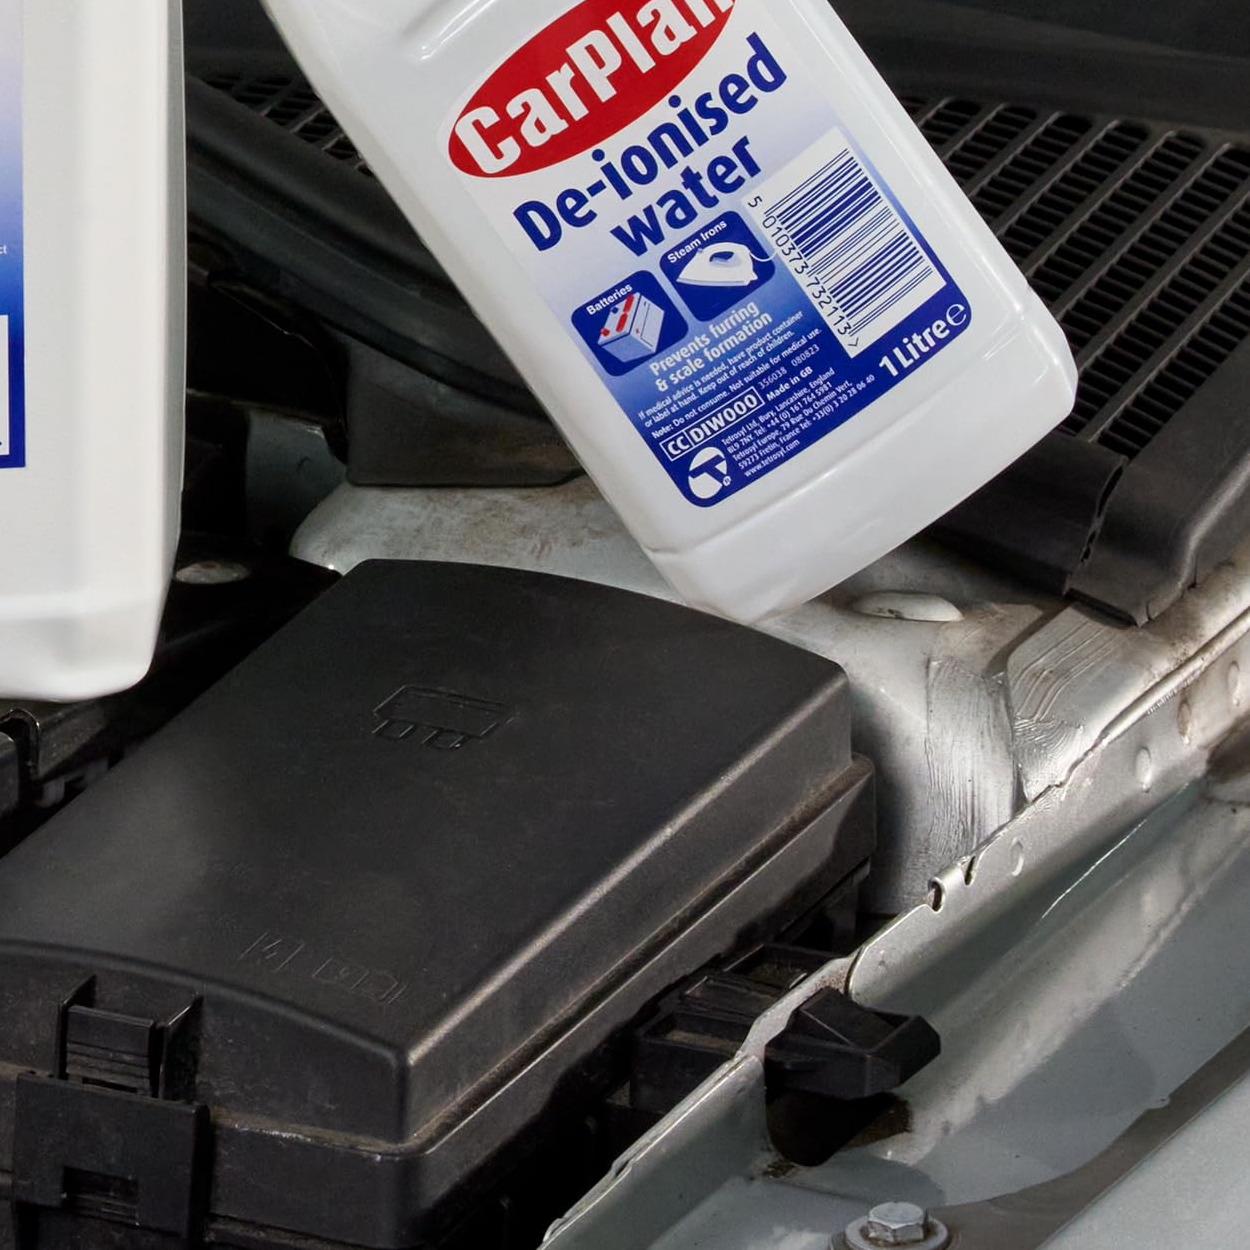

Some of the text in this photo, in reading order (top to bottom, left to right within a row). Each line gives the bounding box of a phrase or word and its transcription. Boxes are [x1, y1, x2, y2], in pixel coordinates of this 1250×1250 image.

[513, 31, 787, 252] De-ionised
[610, 135, 762, 257] water
[667, 220, 727, 263] Steam Irons
[747, 194, 852, 336] 5 010373 732113
[586, 284, 632, 315] Batteries
[637, 411, 645, 420] If
[645, 395, 672, 416] medical
[672, 384, 694, 401] advice
[700, 361, 729, 383] needed,
[726, 350, 746, 365] have
[745, 332, 773, 356] product
[771, 310, 803, 335] container
[648, 301, 760, 376] Prevents furring
[655, 312, 772, 392] & scale formation
[757, 343, 820, 389] 356038 080823
[878, 355, 898, 377] 1
[892, 319, 950, 368] Litre
[644, 419, 653, 427] or
[651, 407, 670, 423] label
[670, 403, 679, 412] at
[697, 381, 717, 395] Keep
[716, 372, 730, 384] out
[728, 365, 738, 376] of
[737, 355, 757, 371] reach
[756, 346, 766, 357] of
[765, 330, 794, 352] children.
[651, 328, 820, 439] Note: Do not consume. Not suitable for medical use.
[766, 366, 813, 401] Made in GB
[667, 435, 690, 455] CC
